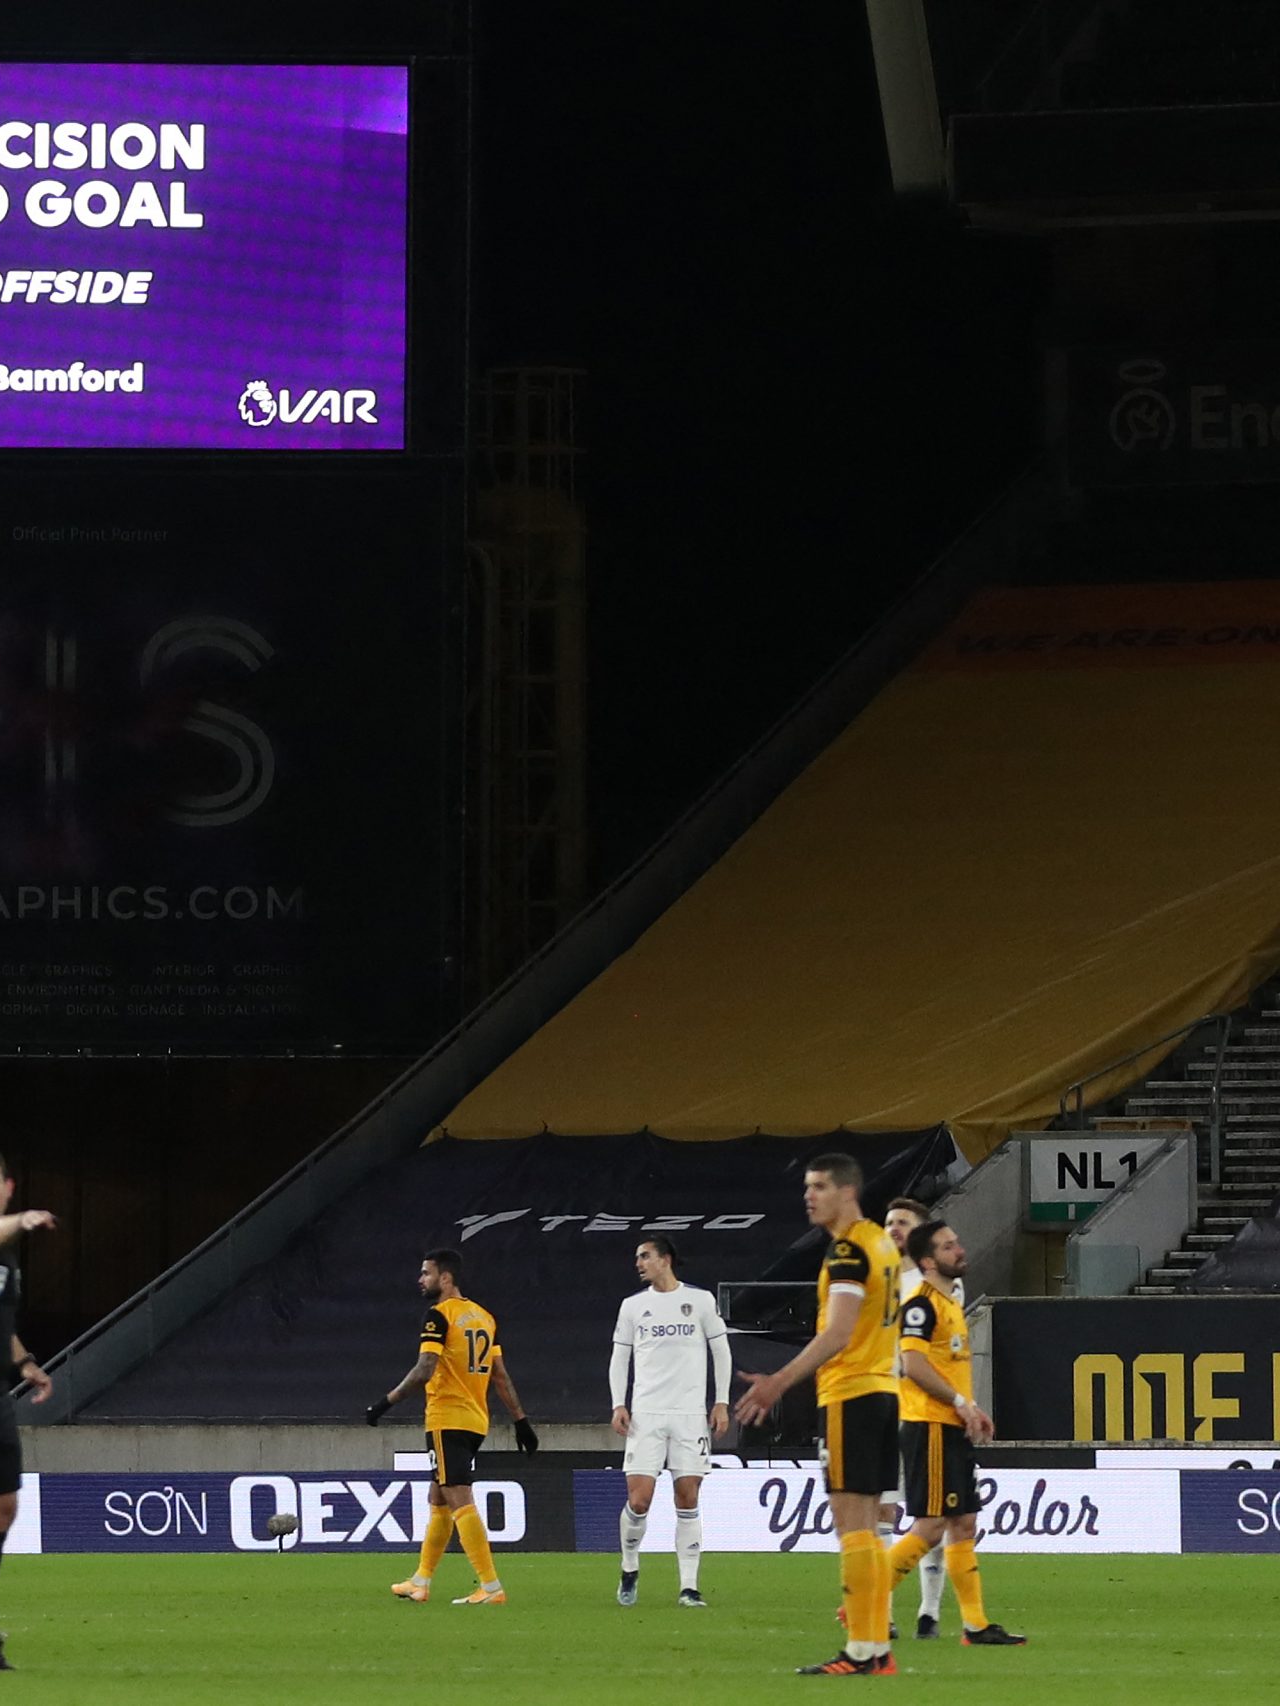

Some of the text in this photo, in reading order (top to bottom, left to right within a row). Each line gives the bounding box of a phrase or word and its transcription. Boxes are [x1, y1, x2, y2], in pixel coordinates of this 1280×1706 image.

[24, 179, 203, 228] GOAL
[279, 389, 378, 424] VAR
[1190, 384, 1280, 449] En
[13, 526, 168, 541] Official Print Partner
[45, 964, 112, 976] GRAPHICS
[152, 964, 216, 976] INTERIOR
[8, 983, 115, 996] ENVIRONMENTS
[130, 983, 170, 996] GIANT
[177, 983, 220, 996] MEDIA
[66, 1003, 118, 1016] DIGITAL
[127, 1003, 185, 1016] SIGNAGE
[1057, 1151, 1137, 1189] NL1
[651, 1324, 696, 1338] SBOTOP
[464, 1328, 490, 1374] 12
